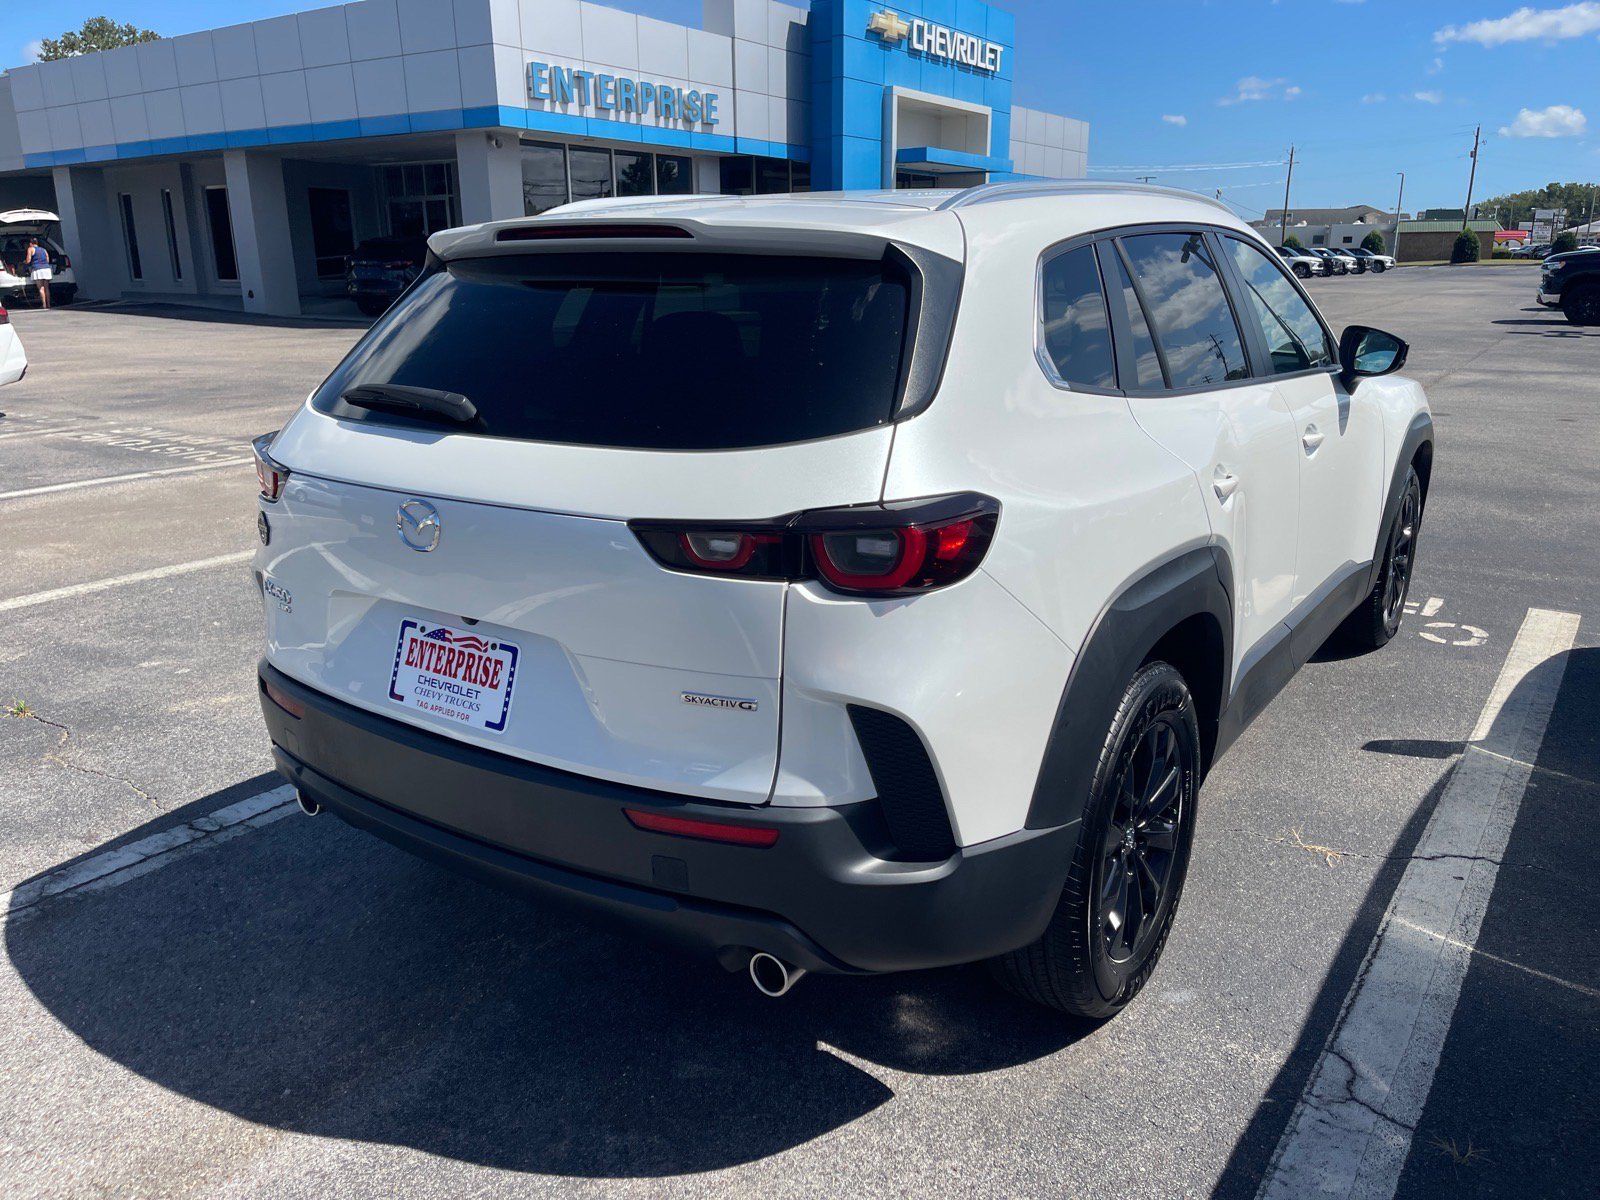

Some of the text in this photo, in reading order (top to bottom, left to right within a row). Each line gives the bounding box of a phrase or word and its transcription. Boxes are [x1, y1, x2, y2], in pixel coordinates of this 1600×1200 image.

[908, 18, 1004, 72] CHEVROLET
[526, 61, 720, 125] ENTERPRISE
[405, 637, 503, 690] ENTERPRISE
[414, 686, 481, 712] CHEVY TRUCKS
[417, 674, 482, 700] CHEVROLET
[416, 700, 470, 722] TAG APPLIED FOR
